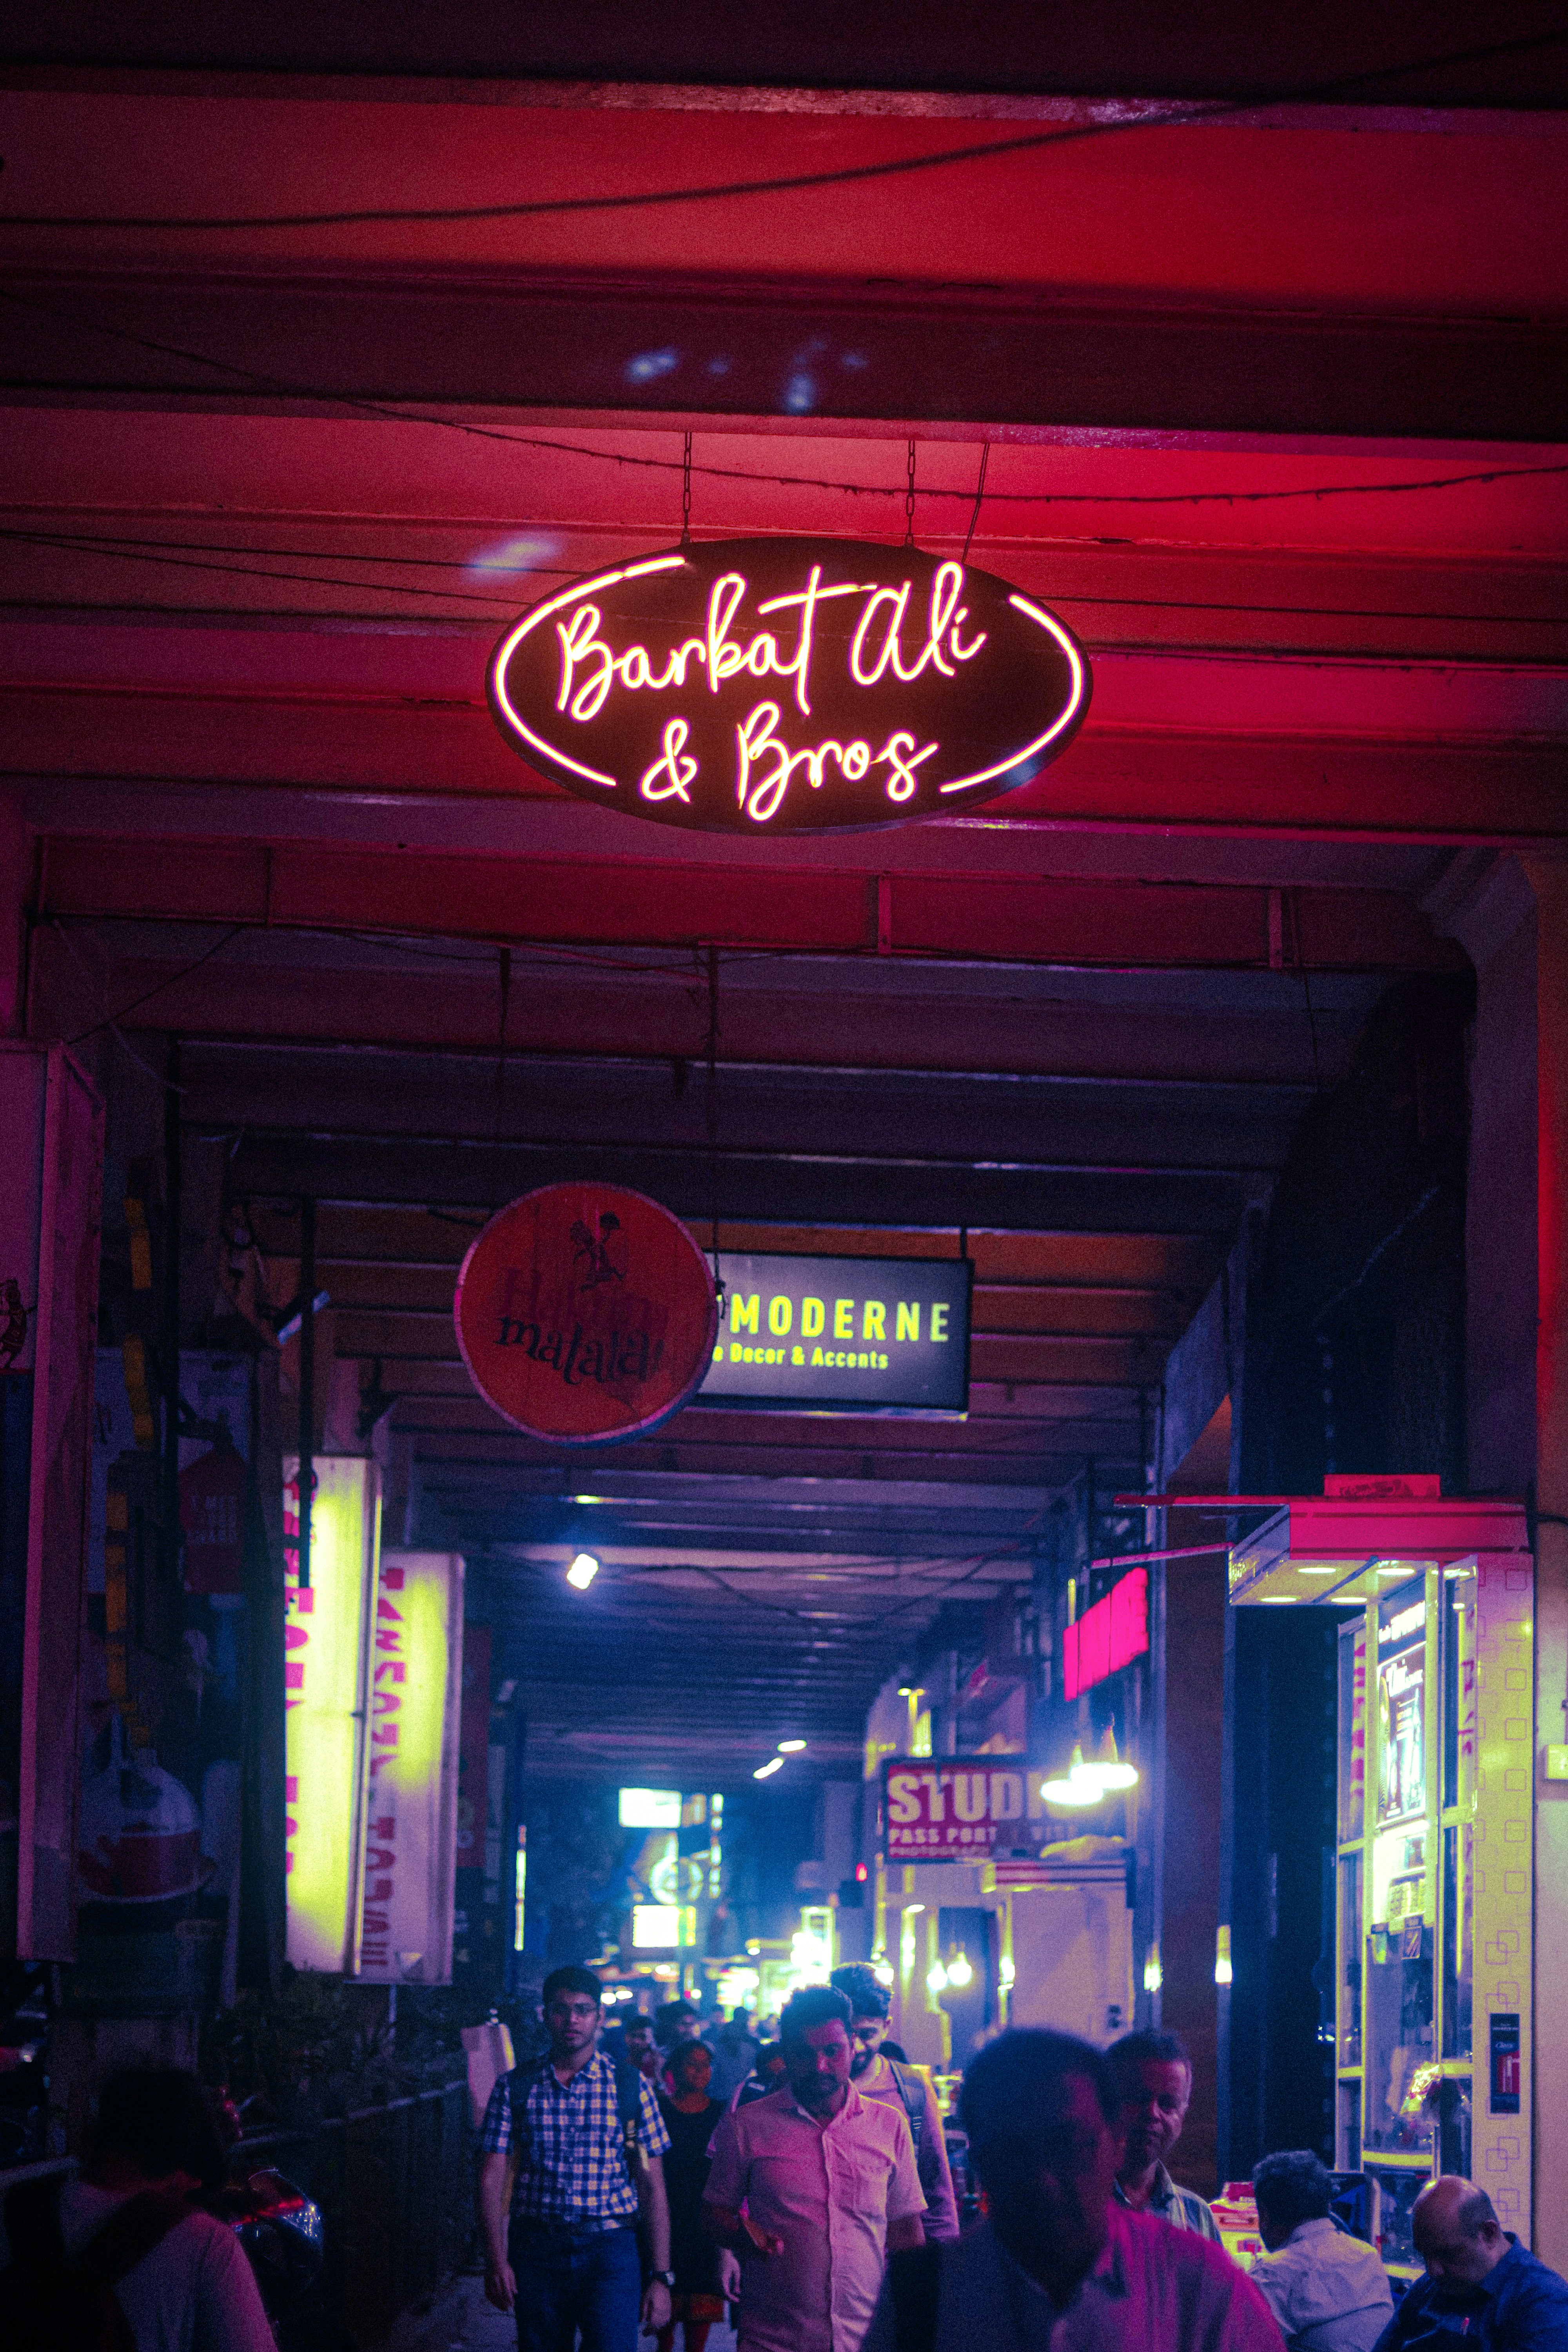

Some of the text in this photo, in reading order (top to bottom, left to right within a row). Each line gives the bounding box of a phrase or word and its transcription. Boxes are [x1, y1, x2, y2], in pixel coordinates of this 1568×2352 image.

[851, 561, 987, 686] Ali
[641, 700, 939, 822] & Bros
[716, 1293, 950, 1343] MODERNE
[729, 1341, 786, 1365] Decor
[790, 1345, 806, 1367] &
[810, 1346, 889, 1370] Accents
